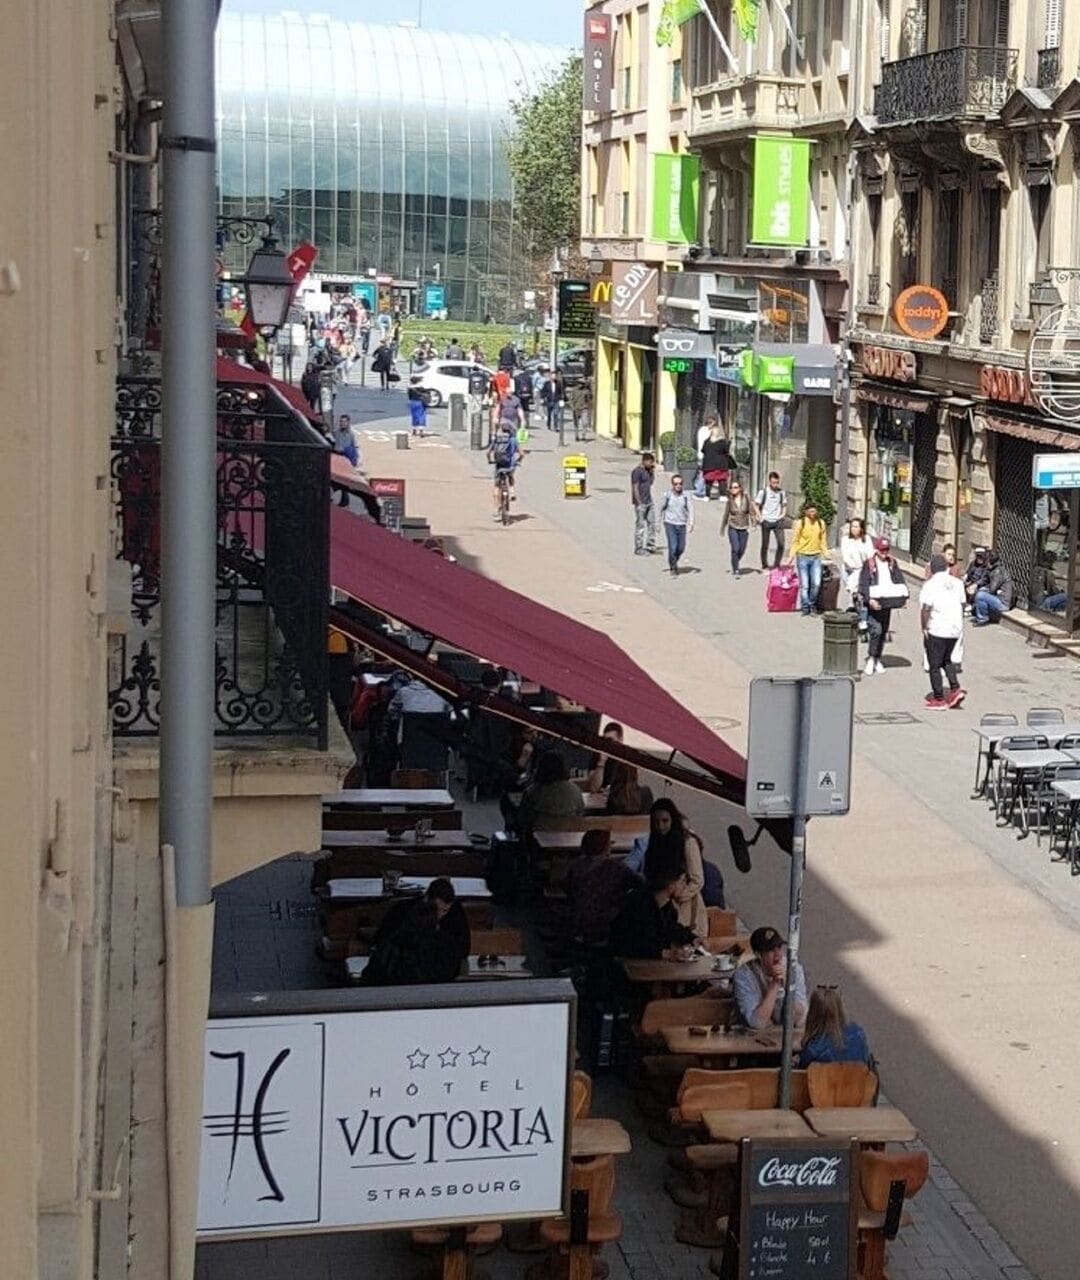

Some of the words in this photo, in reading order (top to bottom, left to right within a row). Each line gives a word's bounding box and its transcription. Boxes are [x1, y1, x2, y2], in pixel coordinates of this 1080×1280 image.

[336, 1105, 554, 1164] VICTORIA
[758, 1156, 842, 1187] Coca-Cola
[367, 1179, 522, 1202] STRASBOURG
[765, 1210, 800, 1231] Happy
[804, 1209, 830, 1225] Hour
